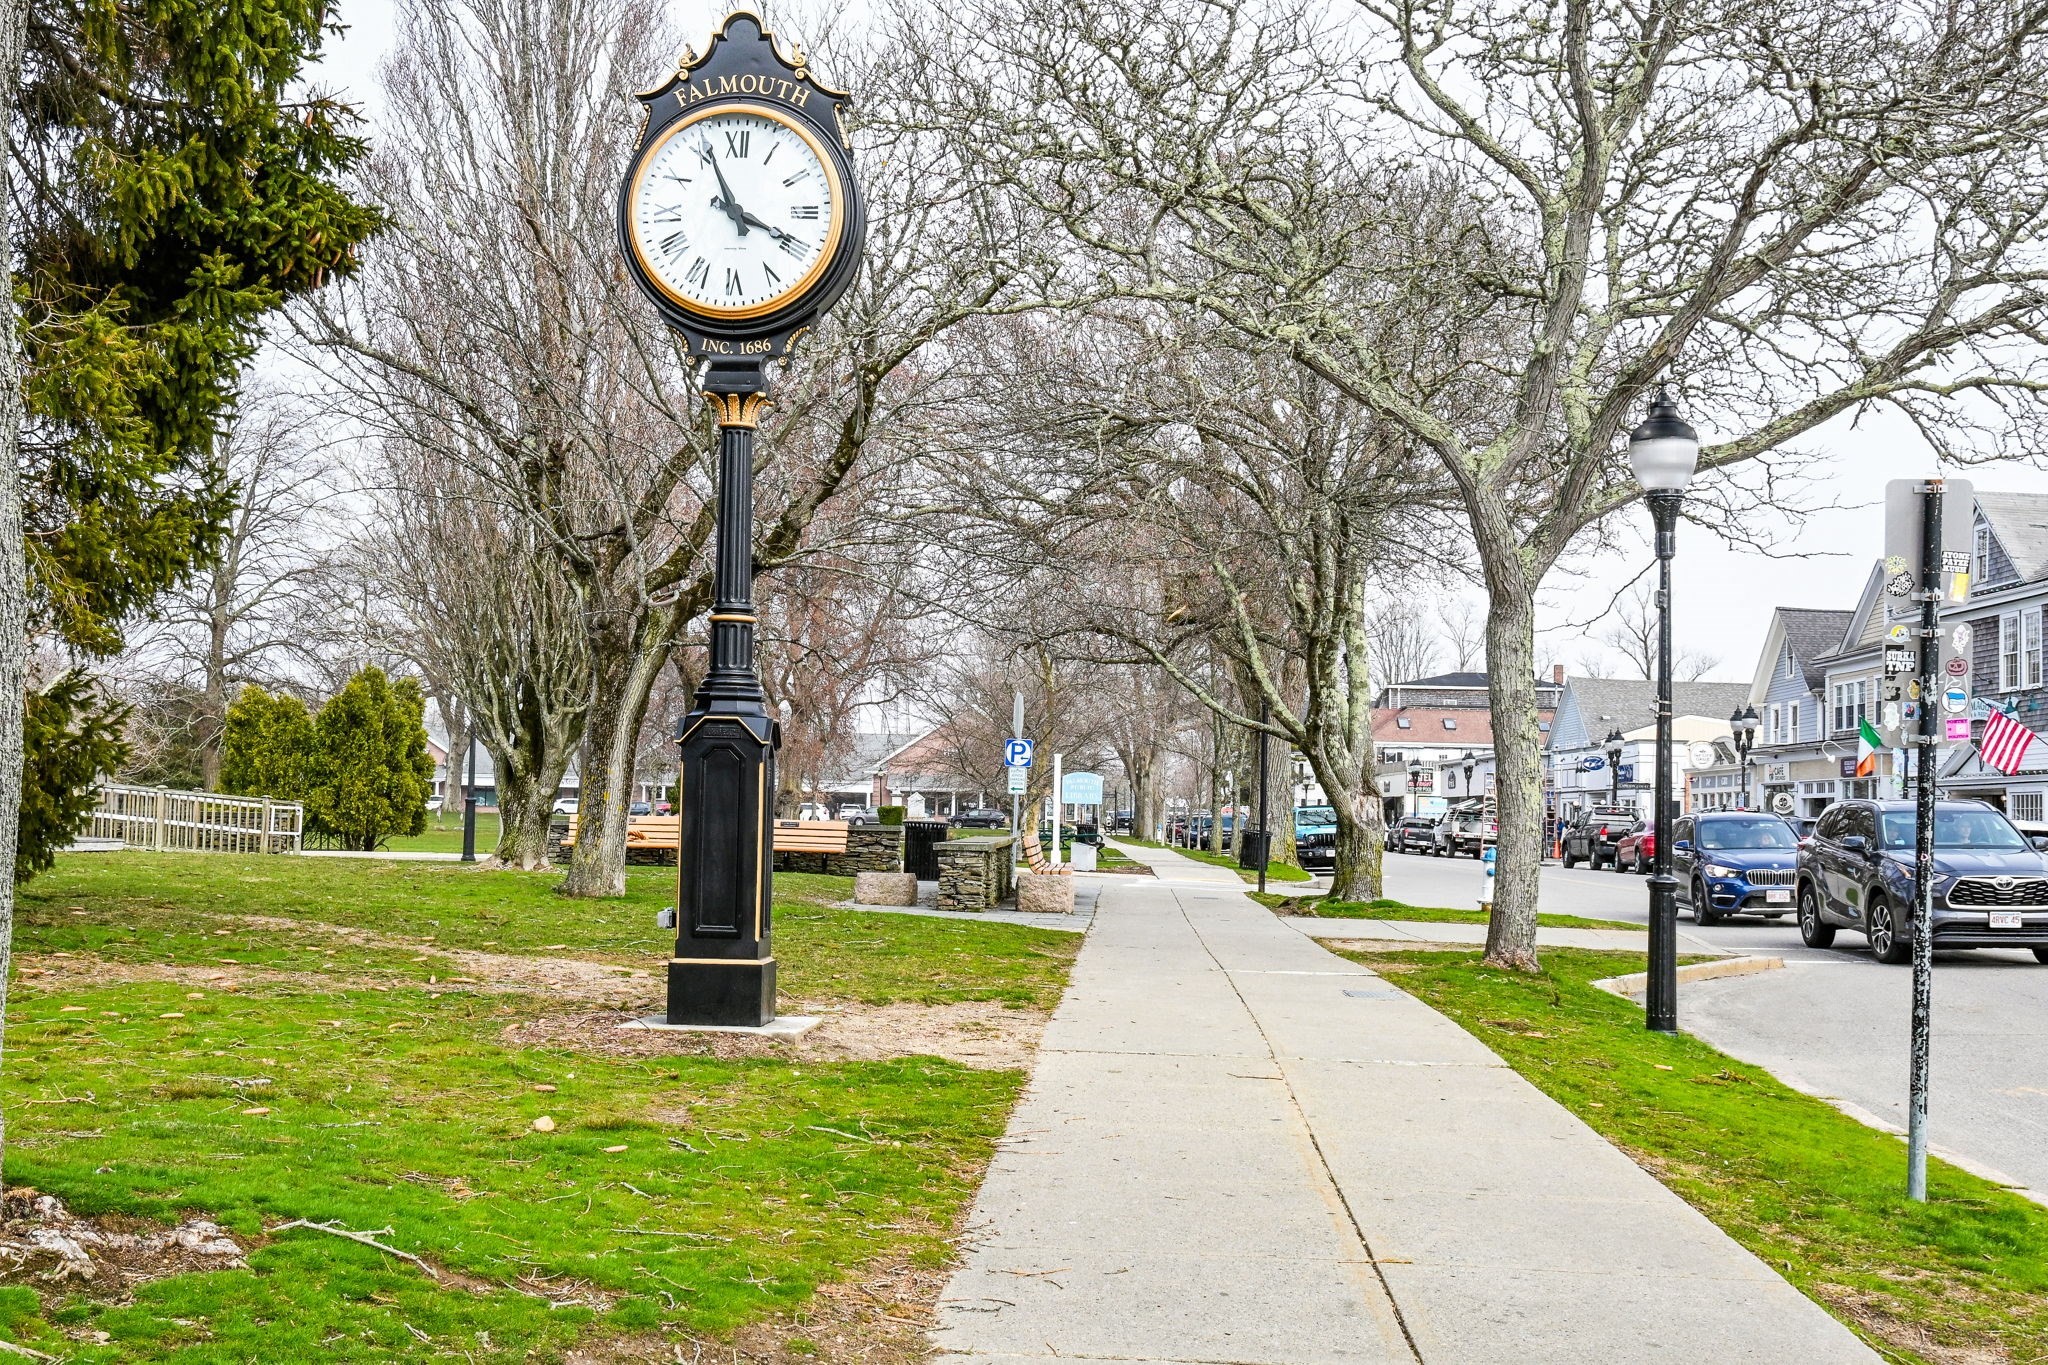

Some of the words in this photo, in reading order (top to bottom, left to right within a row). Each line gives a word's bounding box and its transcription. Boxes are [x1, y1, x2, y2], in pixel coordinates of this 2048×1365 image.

[673, 74, 811, 107] FALMOUTH
[725, 131, 750, 159] XII
[662, 167, 692, 191] X
[783, 168, 810, 188] II
[790, 205, 818, 220] III
[726, 267, 743, 296] VI
[762, 261, 781, 288] V
[701, 338, 733, 354] INC.
[740, 338, 772, 355] 1686
[1886, 661, 1915, 672] TNP
[1011, 743, 1026, 762] P
